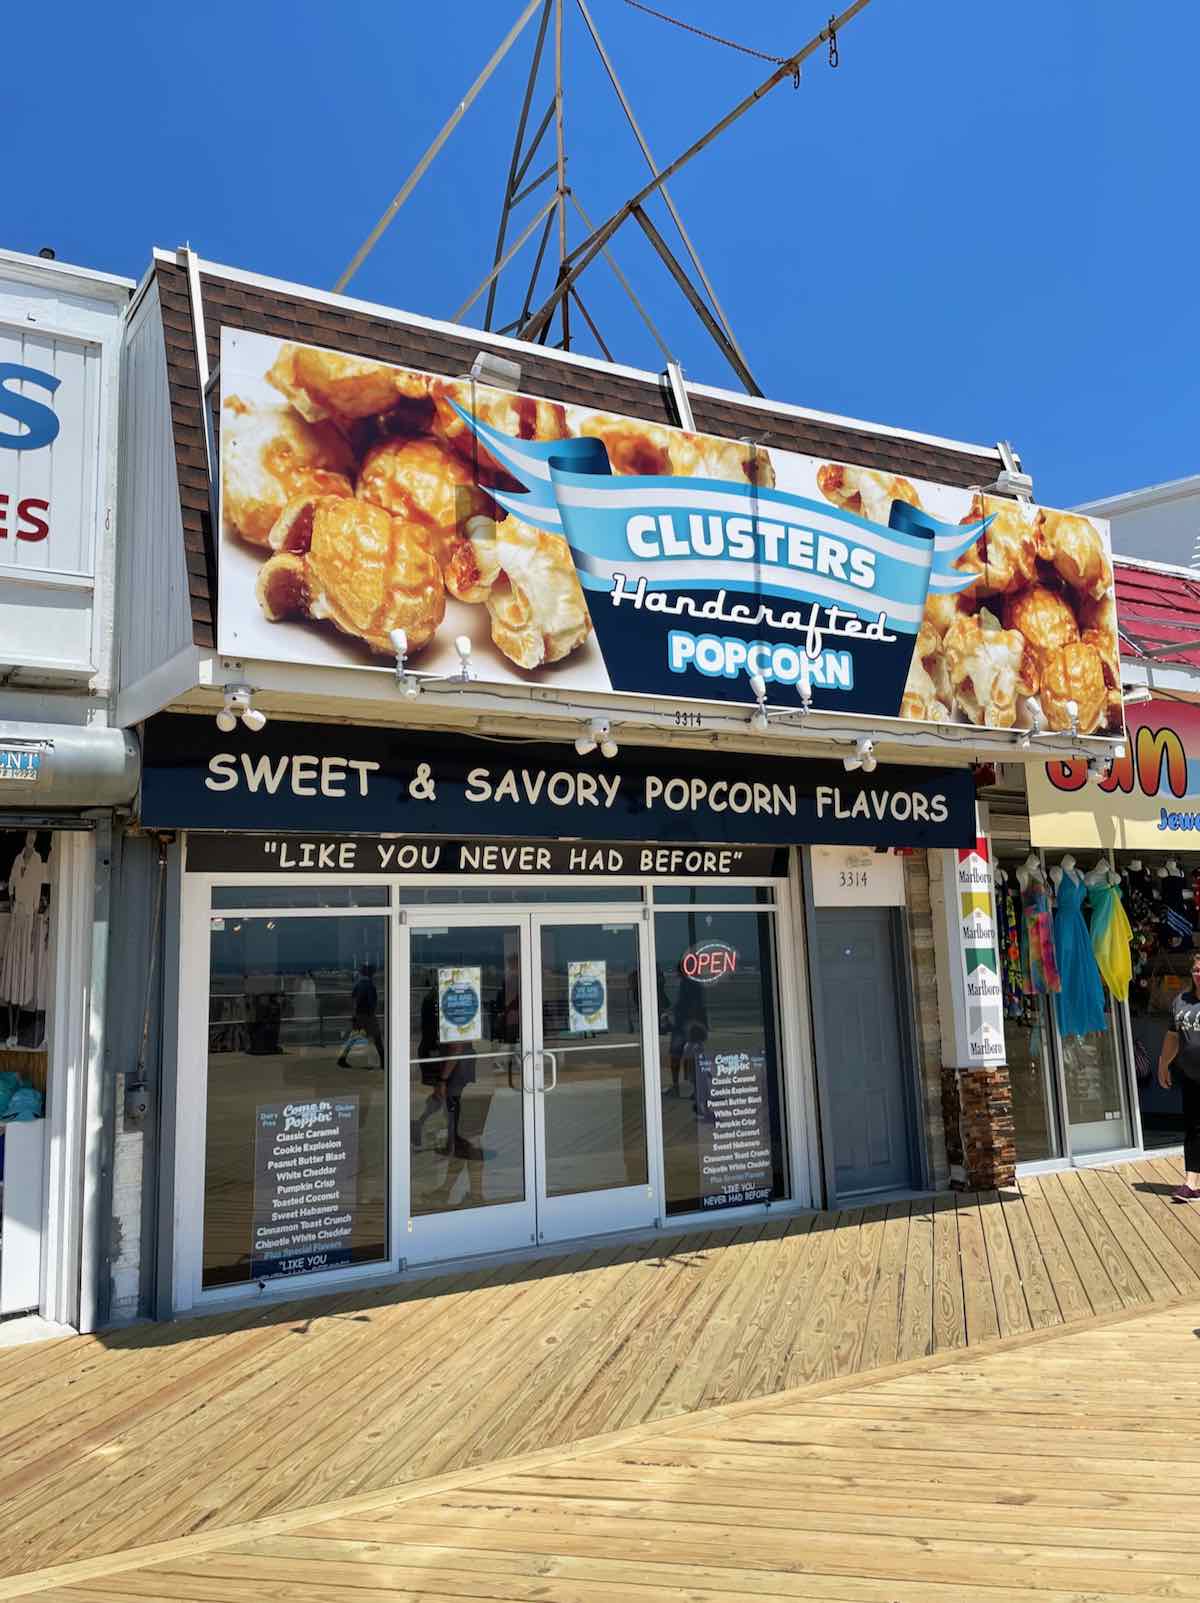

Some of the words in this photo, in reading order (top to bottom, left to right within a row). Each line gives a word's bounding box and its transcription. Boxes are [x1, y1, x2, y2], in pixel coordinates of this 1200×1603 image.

[626, 514, 877, 589] CLUSTERS
[610, 573, 897, 659] Handcrafted
[669, 631, 853, 689] POPCORN
[675, 711, 701, 727] 3314
[205, 753, 380, 797] SWEET
[409, 763, 436, 800] &
[465, 768, 621, 807] SAVORY
[645, 776, 796, 816] POPCORN
[816, 787, 948, 822] FLAVORS
[264, 843, 357, 868] "LIKE
[377, 845, 440, 869] YOU
[459, 846, 552, 870] NEVER
[569, 848, 623, 871] HAD
[640, 850, 742, 873] BEFORE"
[840, 872, 867, 888] 3314
[959, 869, 992, 884] Marlboro
[963, 923, 995, 940] Marlboro
[683, 951, 736, 975] OPEN
[967, 980, 1000, 996] Marlboro
[970, 1038, 1003, 1056] Marlboro
[276, 1131, 305, 1142] Classic
[306, 1127, 339, 1139] Caramel
[273, 1144, 302, 1155] Cookie
[303, 1140, 342, 1152] Explosion
[267, 1159, 297, 1170] Peanut
[298, 1155, 325, 1166] Butter
[325, 1152, 346, 1162] Blast
[276, 1171, 301, 1181] White
[303, 1166, 336, 1177] Cheddar
[277, 1184, 313, 1194] Pumpkin
[314, 1179, 335, 1189] Crisp
[272, 1196, 304, 1208] Toasted
[306, 1190, 340, 1202] Coconut
[271, 1210, 298, 1221] Sweet
[300, 1205, 339, 1217] Habanero
[257, 1224, 298, 1236] Cinnamon
[300, 1219, 322, 1229] Toast
[324, 1214, 352, 1226] Crunch
[255, 1237, 290, 1250] Chipotle
[292, 1233, 316, 1244] White
[318, 1227, 352, 1239] Cheddar
[279, 1257, 305, 1271] "LIKE
[307, 1254, 328, 1266] YOU
